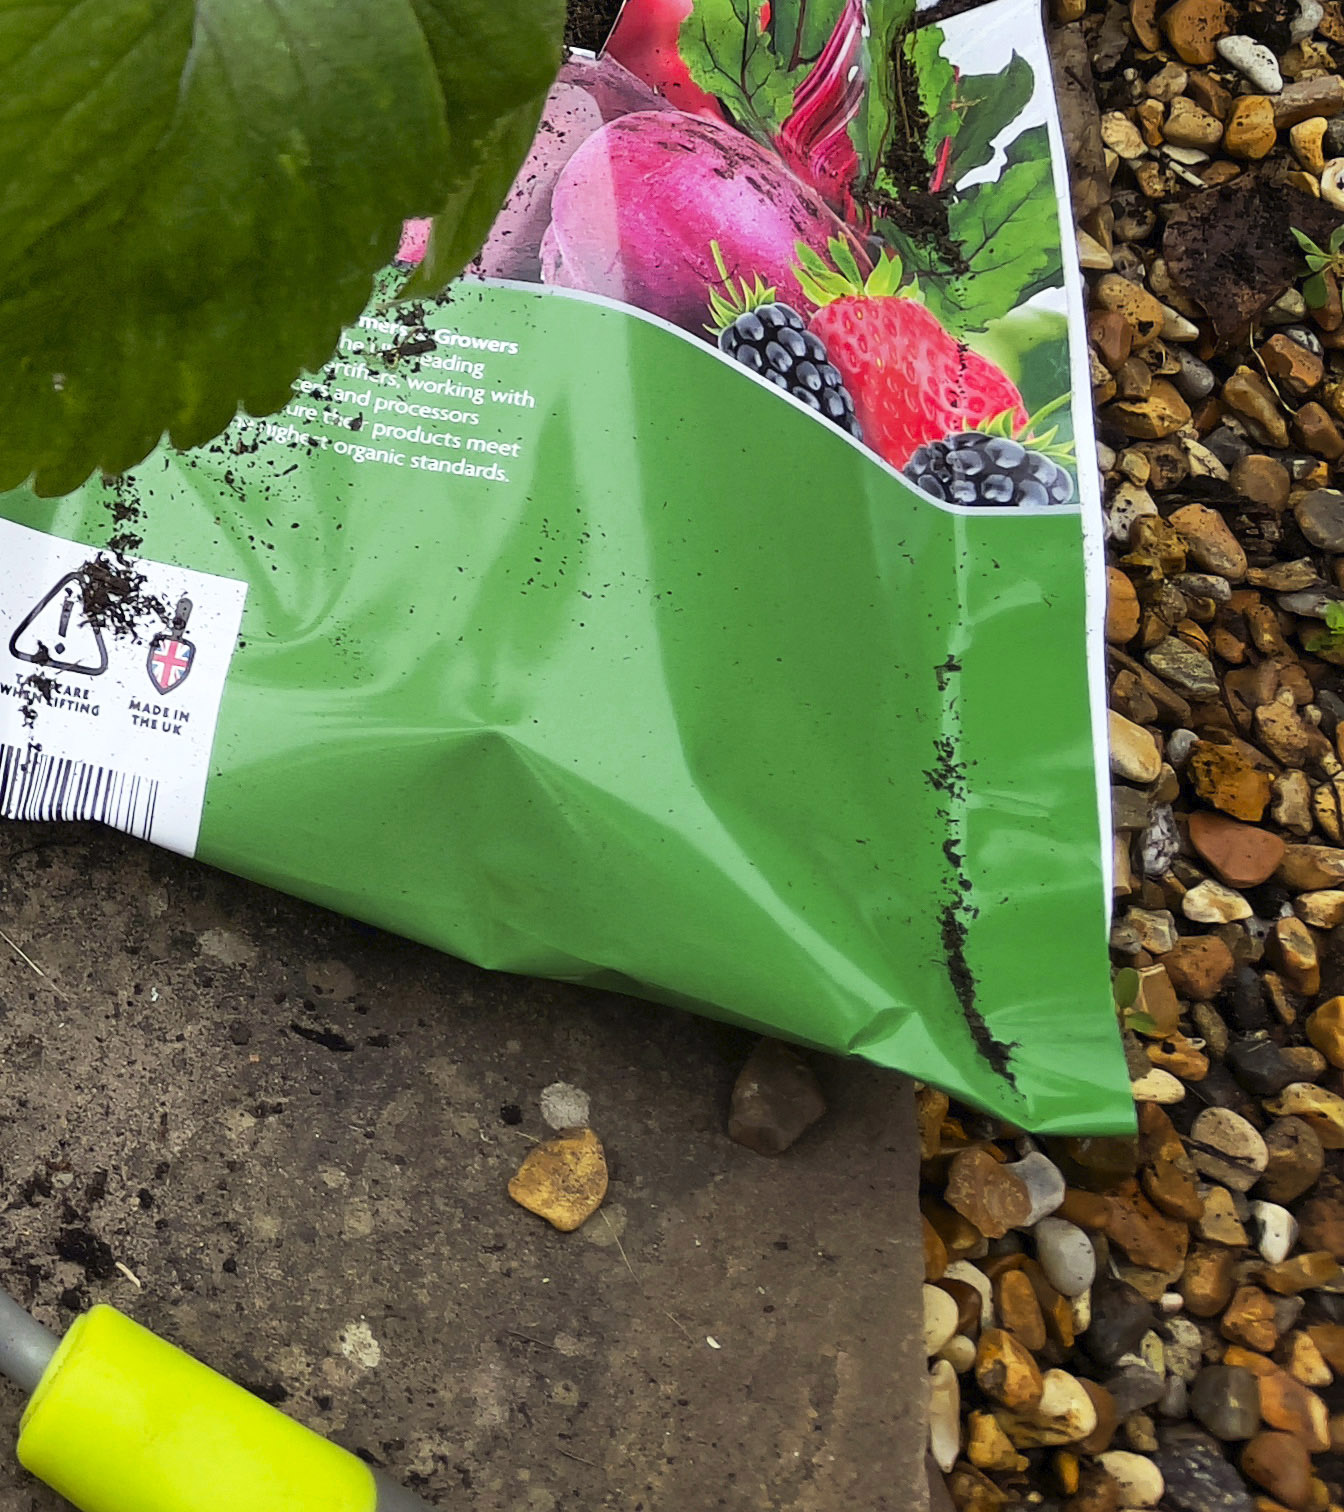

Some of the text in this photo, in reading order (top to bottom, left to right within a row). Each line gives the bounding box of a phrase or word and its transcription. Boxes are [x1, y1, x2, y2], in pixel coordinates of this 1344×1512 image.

[434, 329, 519, 354] Growers
[420, 354, 485, 379] eading
[407, 375, 536, 408] working with
[333, 388, 371, 406] and
[374, 396, 480, 425] processors
[372, 423, 522, 458] products meet
[333, 440, 510, 483] organic standards.
[129, 700, 190, 723] MADE IN
[132, 714, 182, 736] THE UK
